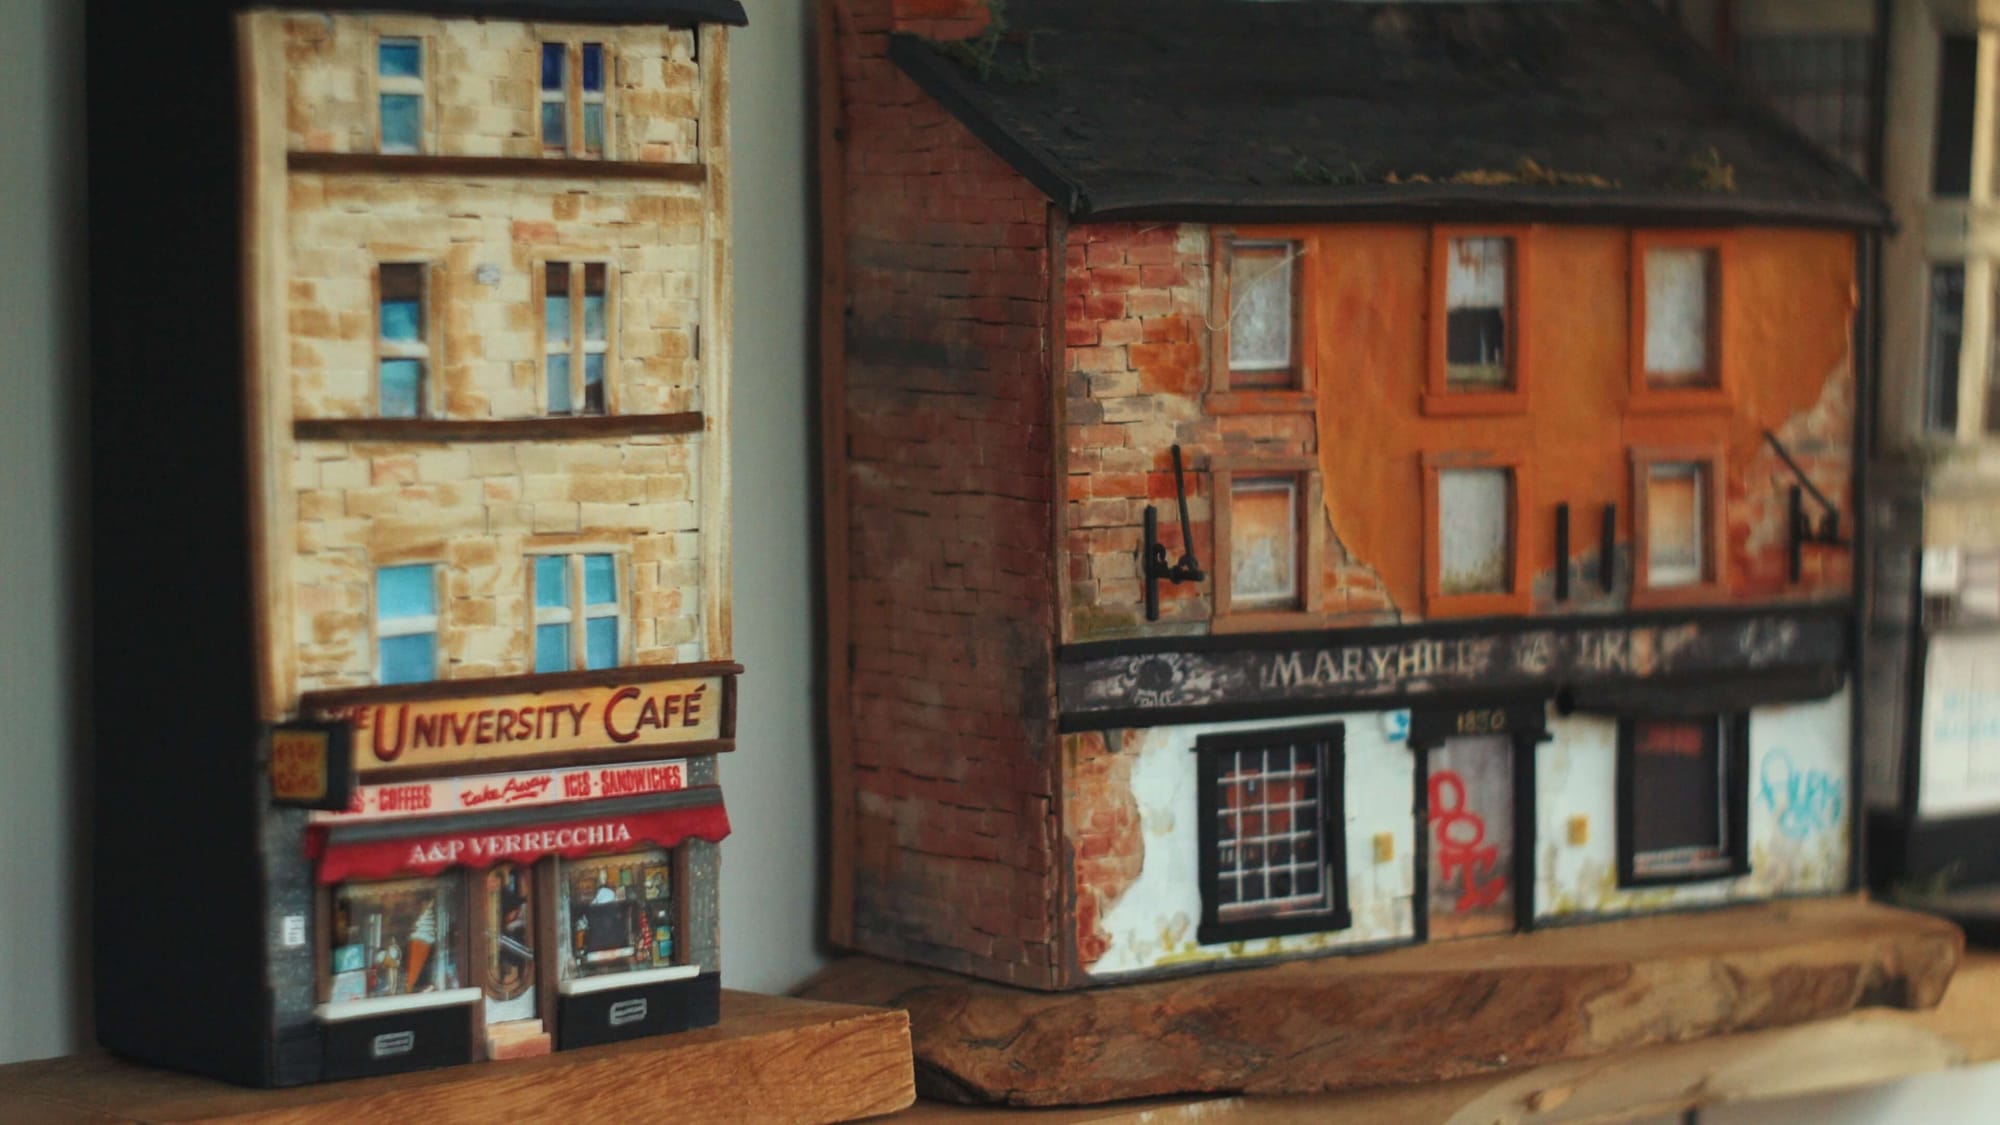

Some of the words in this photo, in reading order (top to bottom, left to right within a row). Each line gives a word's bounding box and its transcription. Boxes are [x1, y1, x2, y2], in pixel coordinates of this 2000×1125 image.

[374, 702, 592, 762] UNIVERSITY
[604, 683, 707, 743] CAFÉ
[563, 771, 592, 798] ICES
[601, 765, 682, 796] SANDWICHES
[408, 839, 465, 865] A&P
[469, 822, 632, 856] VERRECCHIA
